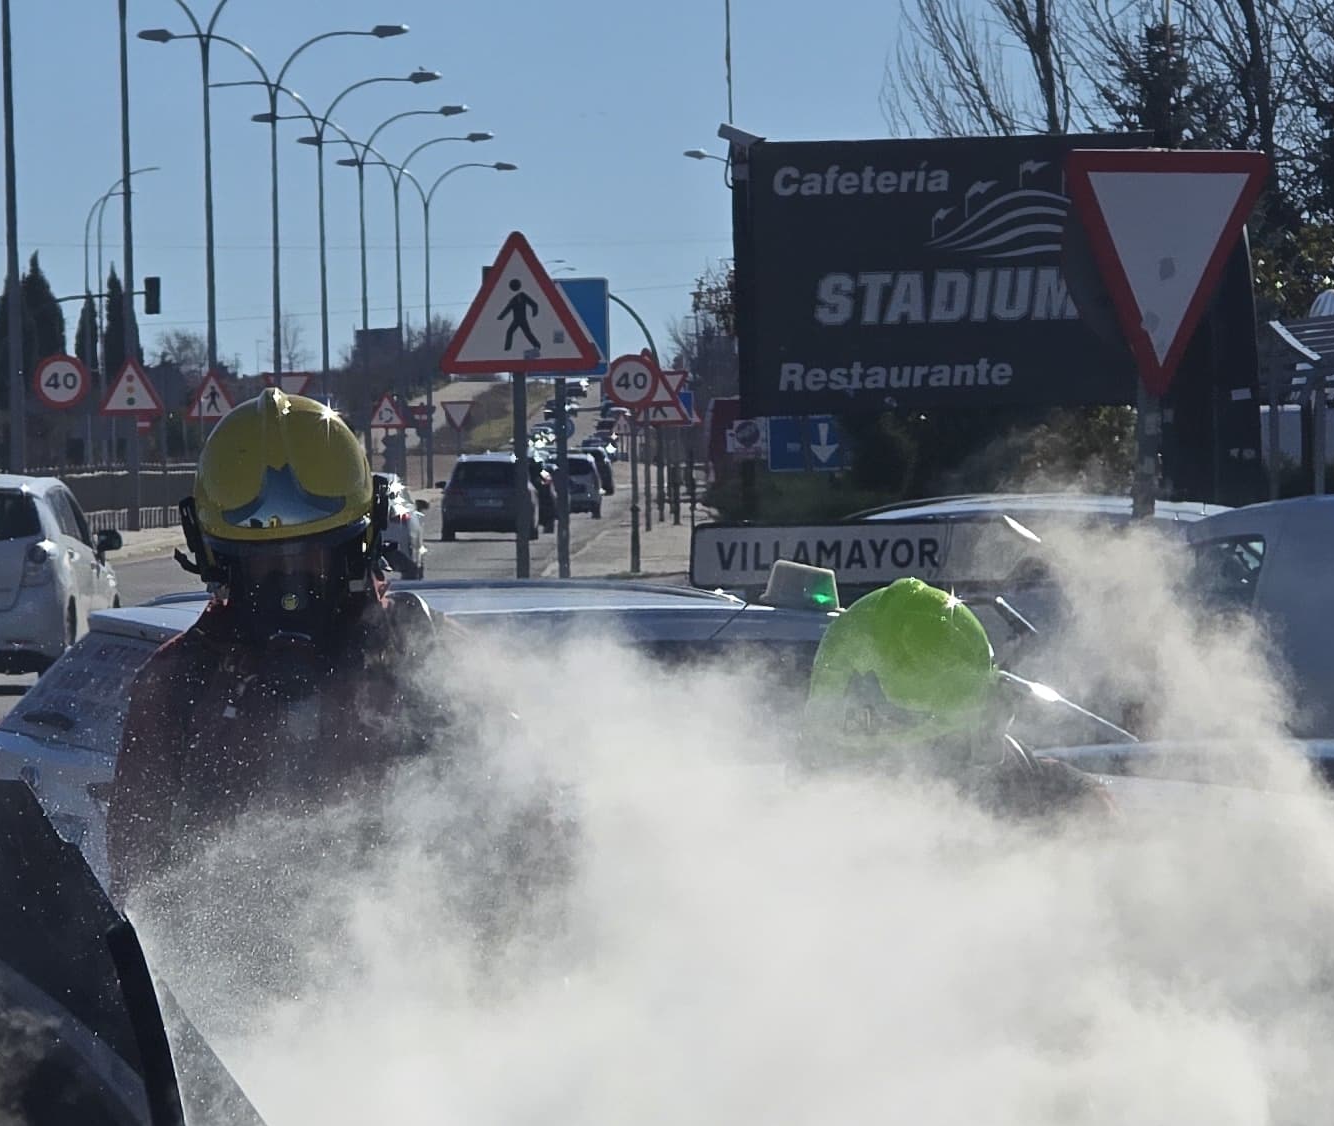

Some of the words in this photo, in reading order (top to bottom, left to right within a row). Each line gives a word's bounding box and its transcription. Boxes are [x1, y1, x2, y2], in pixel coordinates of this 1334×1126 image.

[772, 160, 951, 196] Cafetería
[813, 266, 1082, 326] STADIUM
[45, 372, 77, 390] 40
[616, 372, 648, 390] 40
[778, 357, 1014, 392] Restaurante
[715, 538, 940, 571] VILLAMAYOR
